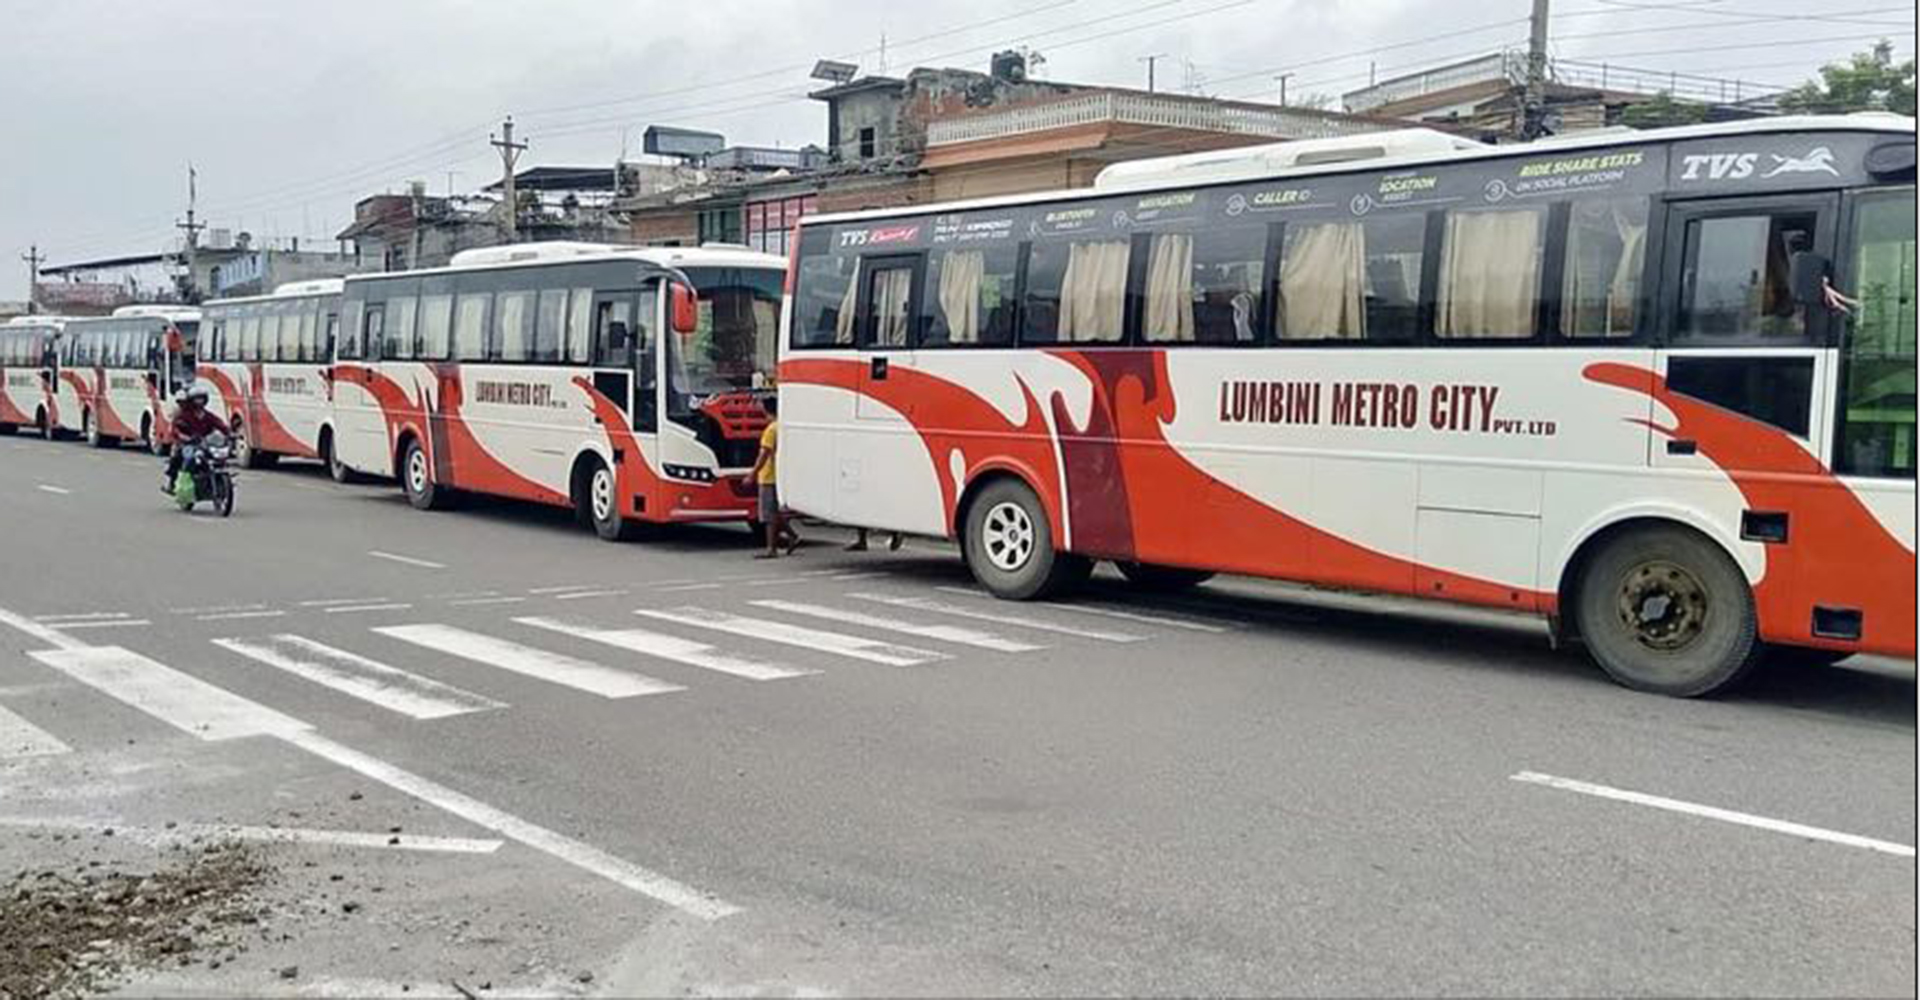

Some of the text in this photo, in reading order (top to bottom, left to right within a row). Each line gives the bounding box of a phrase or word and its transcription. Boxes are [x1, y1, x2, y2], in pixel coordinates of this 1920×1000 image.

[1519, 152, 1644, 176] RIDE SHARE STATS
[1681, 153, 1758, 179] TVS
[1379, 176, 1438, 193] LOCATION
[1567, 170, 1625, 186] PLATFORM
[1254, 190, 1299, 204] CALLER
[841, 230, 868, 246] TVS
[1220, 381, 1321, 424] LUMBINI
[1331, 383, 1418, 429] METRO
[1430, 385, 1499, 432] CITY
